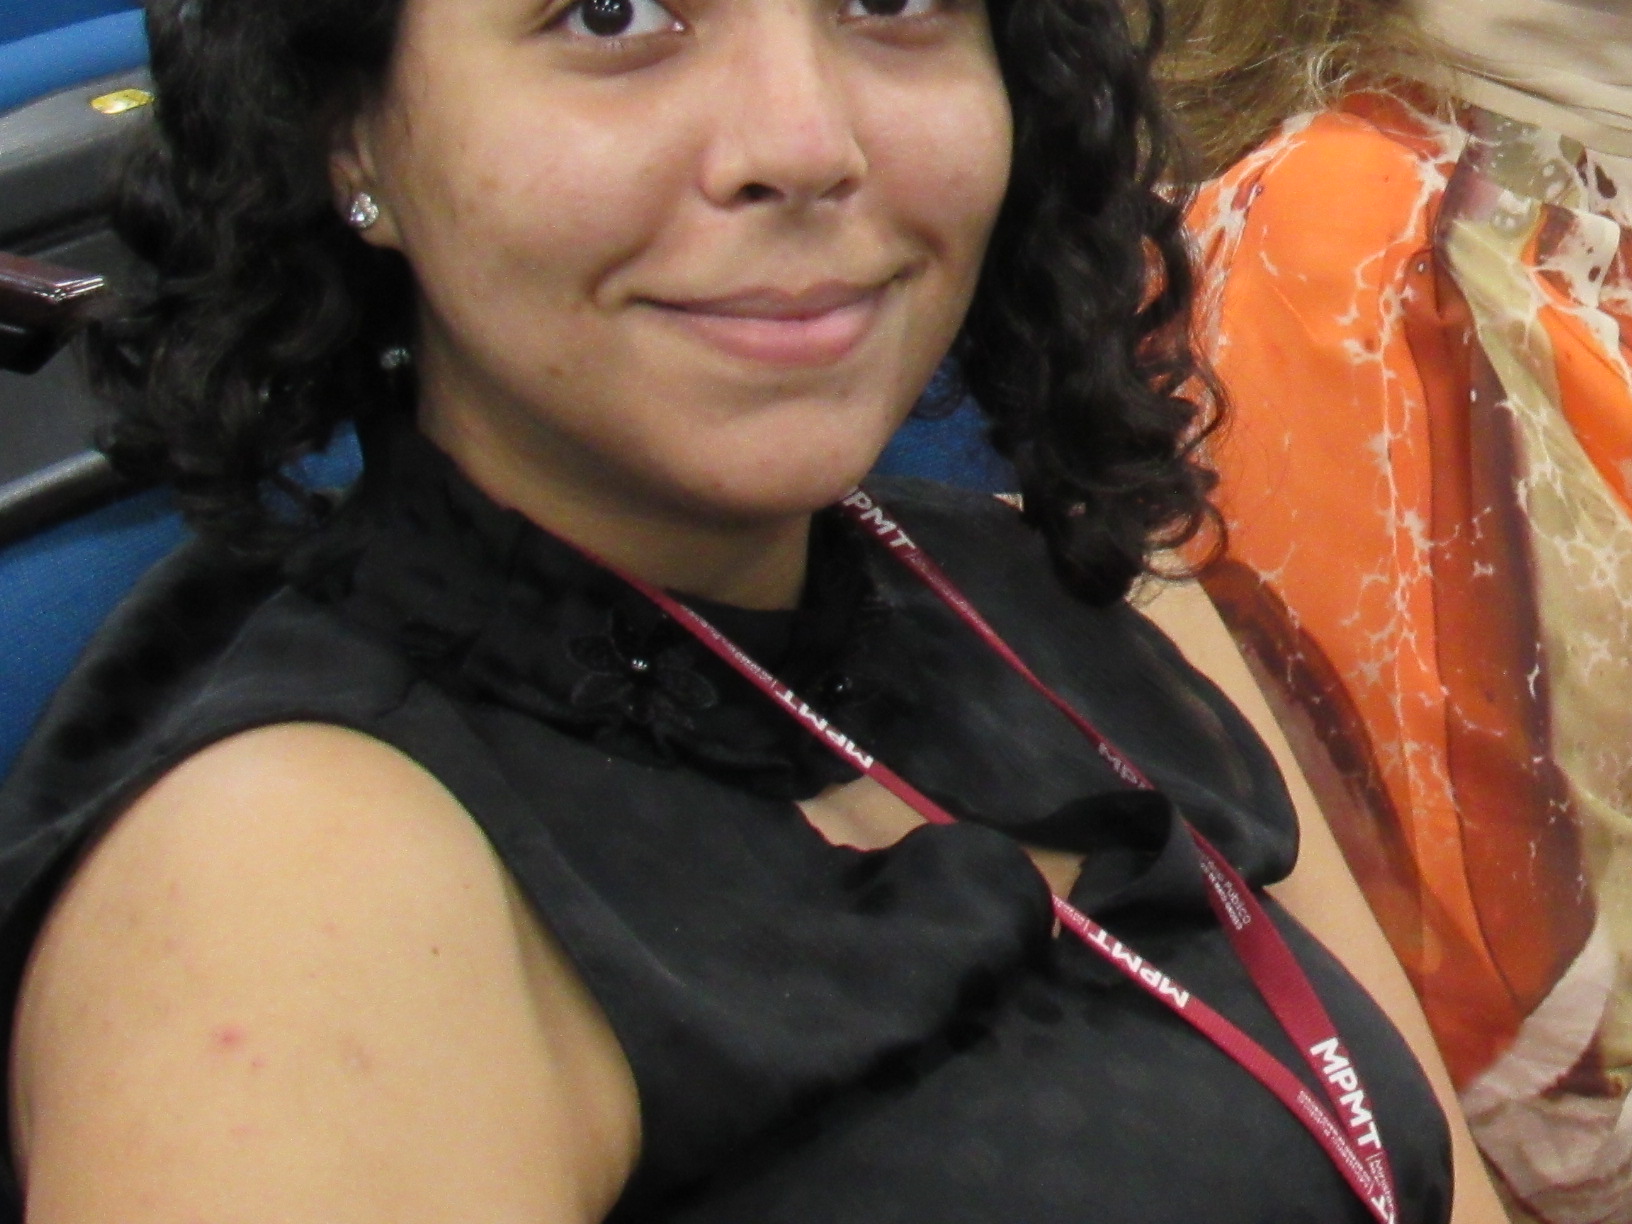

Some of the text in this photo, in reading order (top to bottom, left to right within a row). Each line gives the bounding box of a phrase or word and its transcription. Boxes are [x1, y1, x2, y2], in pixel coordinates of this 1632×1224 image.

[775, 690, 874, 768] MPMT
[1088, 929, 1190, 1008] MPMT
[1310, 1037, 1382, 1149] MPMT
